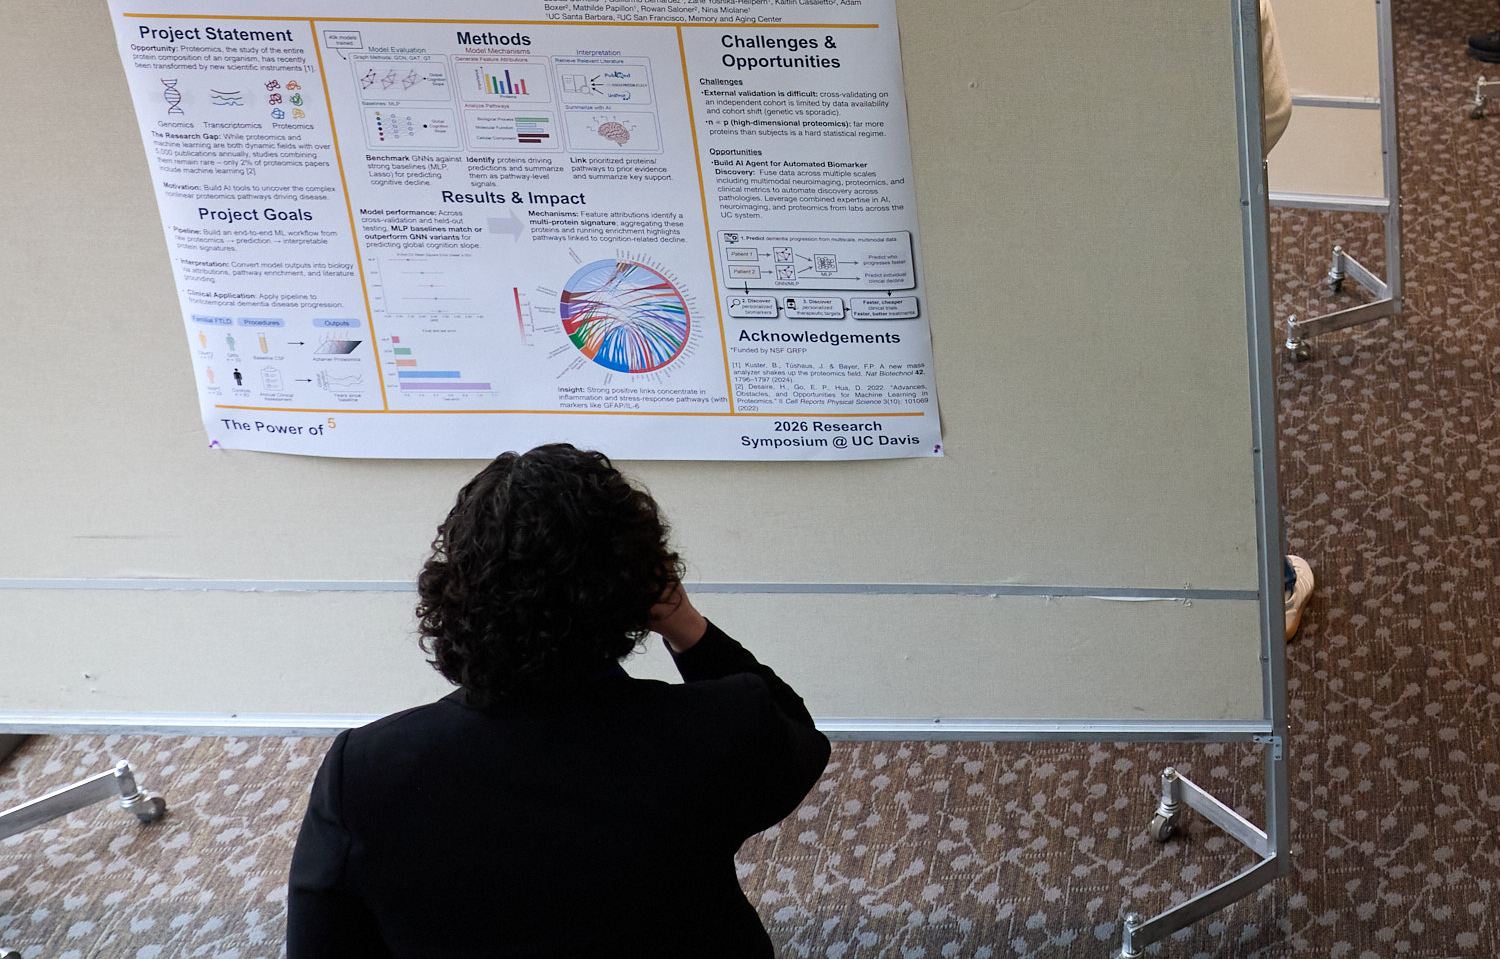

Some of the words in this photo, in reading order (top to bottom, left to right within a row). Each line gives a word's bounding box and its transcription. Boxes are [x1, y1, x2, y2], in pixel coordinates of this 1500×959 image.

[139, 26, 201, 43] Project
[205, 27, 293, 42] Statement
[456, 31, 531, 46] Methods
[130, 44, 179, 53] Opportunity:
[180, 45, 224, 53] Proteomics,
[239, 47, 259, 55] study
[721, 34, 818, 52] Challenges
[824, 35, 837, 49] &
[722, 54, 840, 71] Opportunities
[699, 78, 743, 87] Challenges
[819, 91, 877, 99] cross-validating
[157, 120, 195, 128] Genomics
[203, 121, 262, 130] Transcriptomics
[272, 122, 314, 130] Proteomics
[709, 148, 762, 156] Opportunities
[442, 190, 506, 204] Results
[511, 191, 524, 204] &
[528, 191, 586, 207] Impact
[198, 207, 259, 223] Project
[264, 208, 313, 221] Goals
[739, 329, 901, 346] Acknowledgements
[221, 419, 251, 431] The
[255, 421, 303, 435] Power
[308, 424, 323, 436] of
[328, 417, 336, 429] 5
[774, 421, 808, 432] 2026
[813, 421, 882, 432] Research
[741, 436, 828, 449] Symposium
[832, 436, 848, 449] @
[852, 435, 874, 446] UC
[878, 434, 920, 445] Davis
